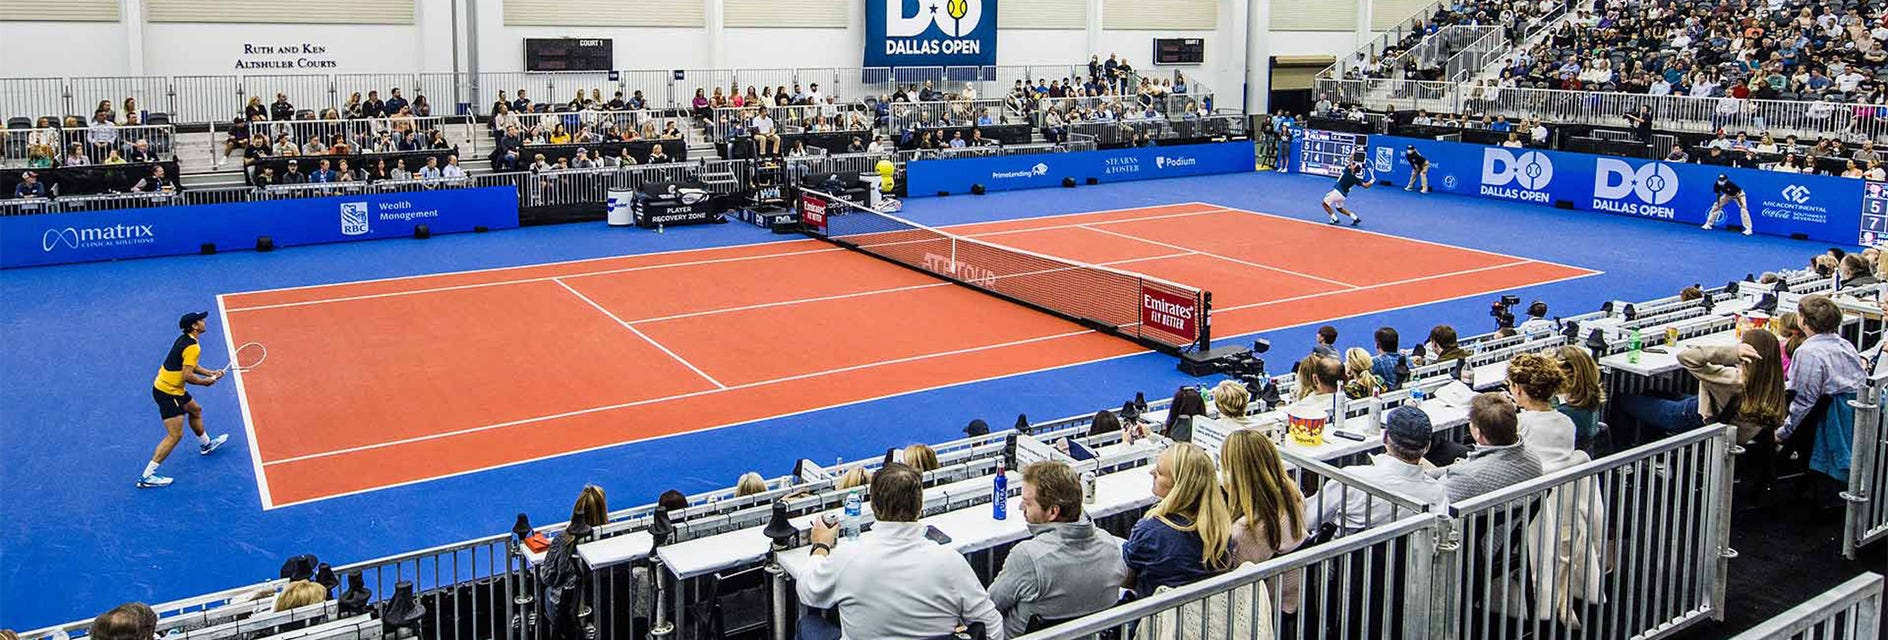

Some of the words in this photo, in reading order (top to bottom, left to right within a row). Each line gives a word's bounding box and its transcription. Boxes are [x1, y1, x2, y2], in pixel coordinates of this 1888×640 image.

[886, 40, 939, 54] DALLAS
[942, 40, 980, 54] OPEN
[1304, 141, 1310, 150] 5
[1315, 142, 1321, 151] 4
[1341, 145, 1351, 155] 15
[1105, 155, 1138, 165] STEARNS
[1166, 156, 1196, 167] Podium
[1303, 152, 1309, 161] 7
[1314, 154, 1320, 162] 4
[992, 171, 1032, 179] PrimeLending
[1480, 185, 1518, 199] DALLAS
[1520, 191, 1550, 203] OPEN
[379, 201, 411, 210] Wealth
[667, 206, 692, 214] PLAYER
[1593, 199, 1637, 214] DALLAS
[1640, 205, 1675, 219] OPEN
[1870, 201, 1880, 213] 5
[380, 209, 438, 221] Management
[652, 213, 687, 222] RECOVERY
[688, 212, 706, 220] ZONE
[345, 224, 367, 233] RBC
[1868, 217, 1880, 230] 7
[81, 224, 154, 241] matrix
[955, 260, 997, 291] TOUR
[1144, 293, 1192, 319] Emirates
[1151, 310, 1161, 324] FLY
[1162, 314, 1185, 330] BETTER
